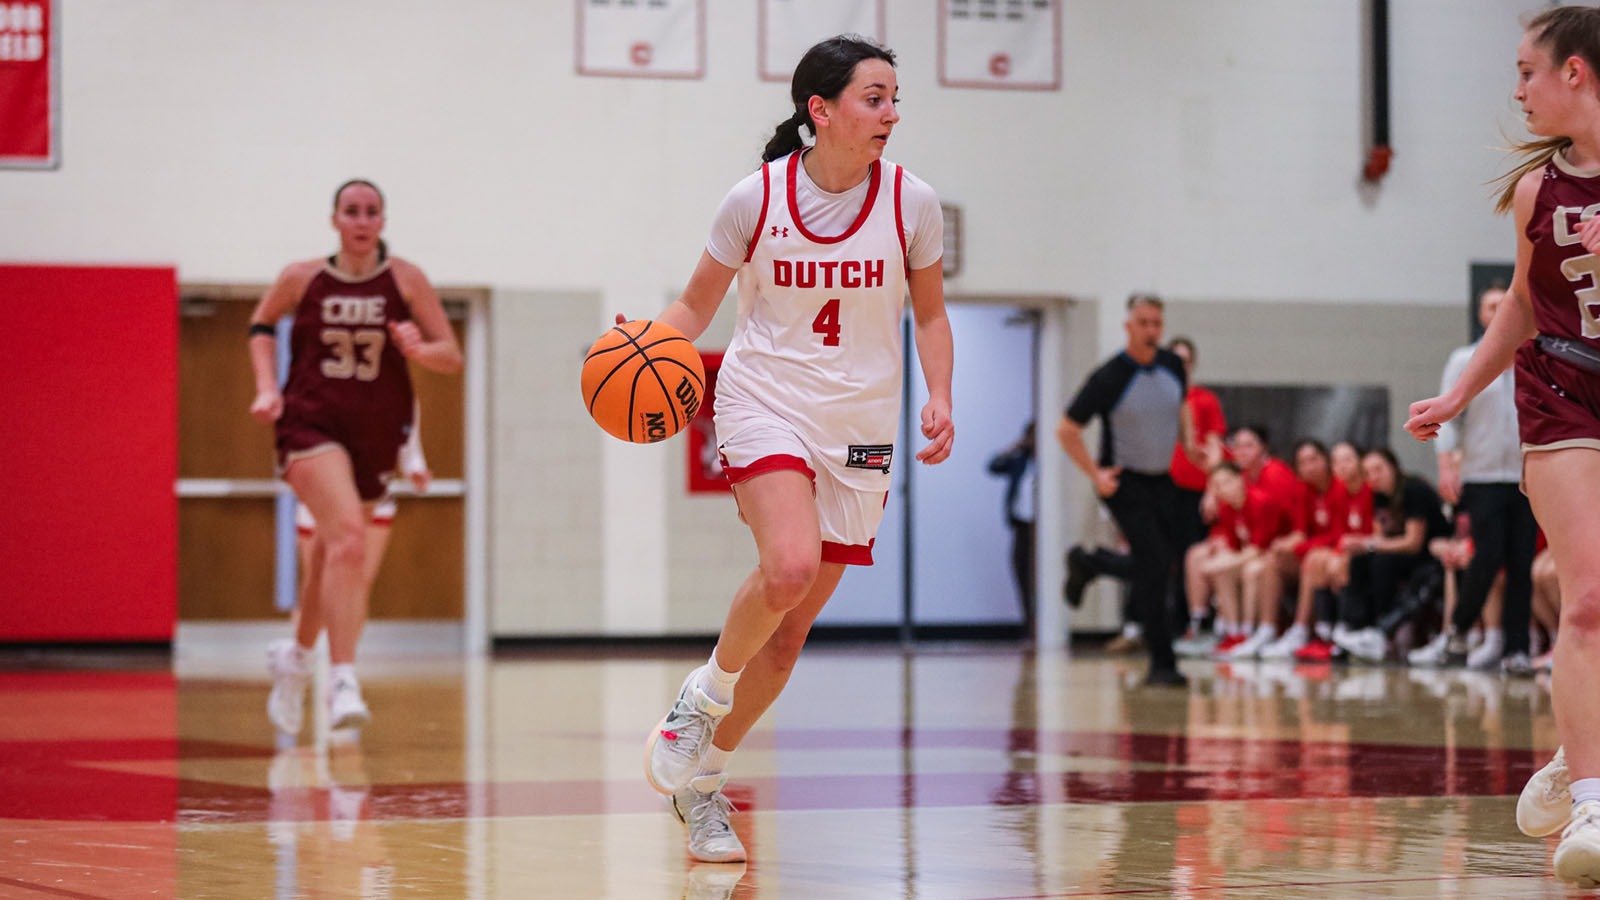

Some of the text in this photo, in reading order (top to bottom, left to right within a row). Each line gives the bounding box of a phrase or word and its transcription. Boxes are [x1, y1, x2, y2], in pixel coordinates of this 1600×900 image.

[773, 259, 884, 288] DUTCH
[322, 295, 387, 325] COE
[812, 299, 841, 347] 4
[321, 328, 386, 381] 33
